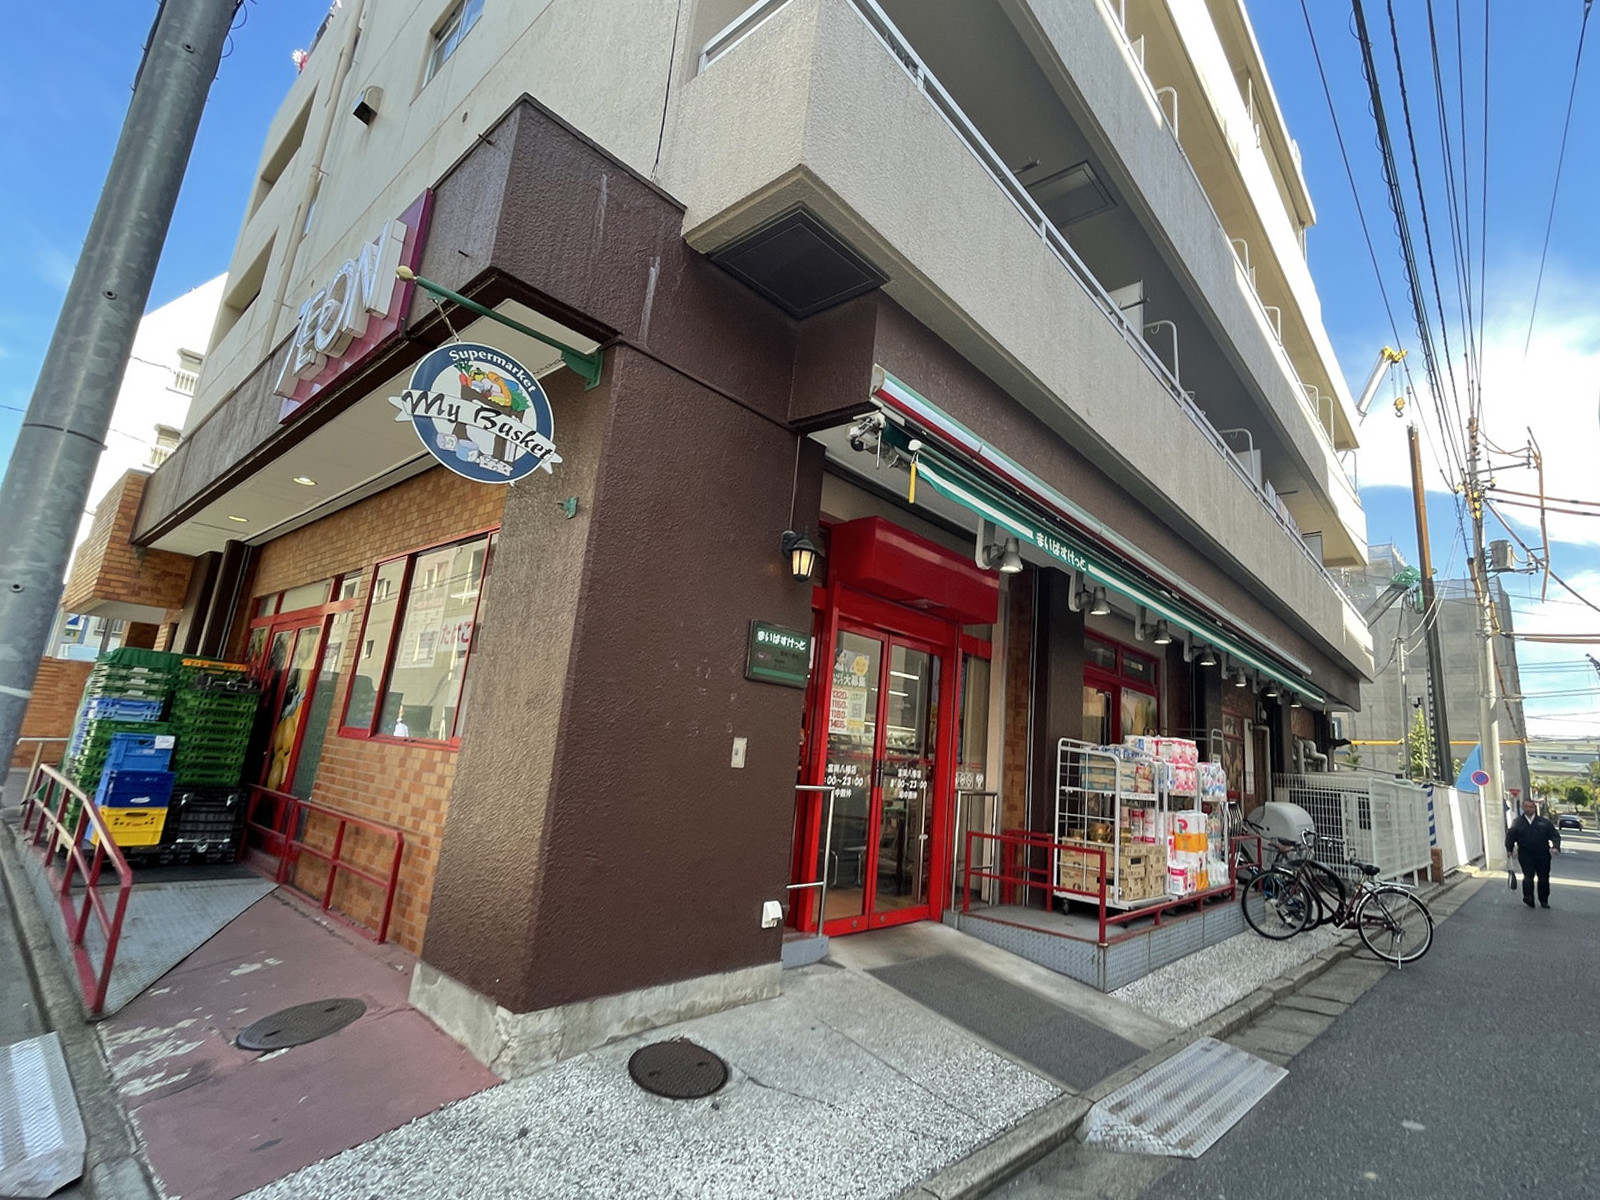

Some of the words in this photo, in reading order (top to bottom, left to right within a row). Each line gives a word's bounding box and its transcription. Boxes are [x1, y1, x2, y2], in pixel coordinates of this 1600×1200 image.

[448, 349, 537, 393] Supermarket
[401, 390, 460, 424] My
[474, 405, 554, 461] Basket
[1035, 531, 1087, 572] まいばすけっと
[757, 630, 806, 651] まいばすけっと
